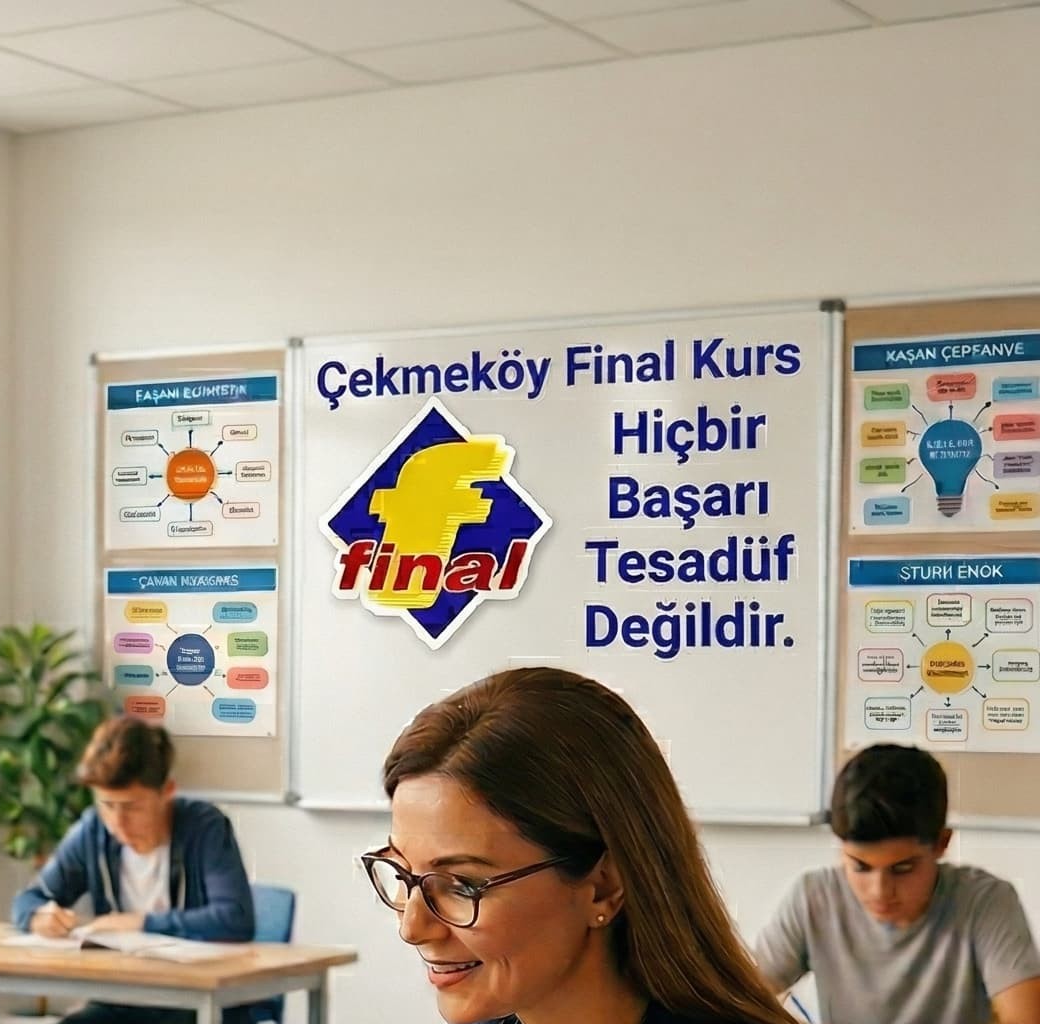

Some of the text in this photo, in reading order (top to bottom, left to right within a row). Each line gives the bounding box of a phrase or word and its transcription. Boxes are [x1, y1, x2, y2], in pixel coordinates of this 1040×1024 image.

[317, 338, 801, 410] Çekmeköy Final Kurs
[613, 404, 766, 463] Hiçbir
[608, 476, 768, 530] Başarı
[338, 540, 528, 593] final
[585, 534, 795, 583] Tesadüf
[585, 600, 795, 659] Değildir.
